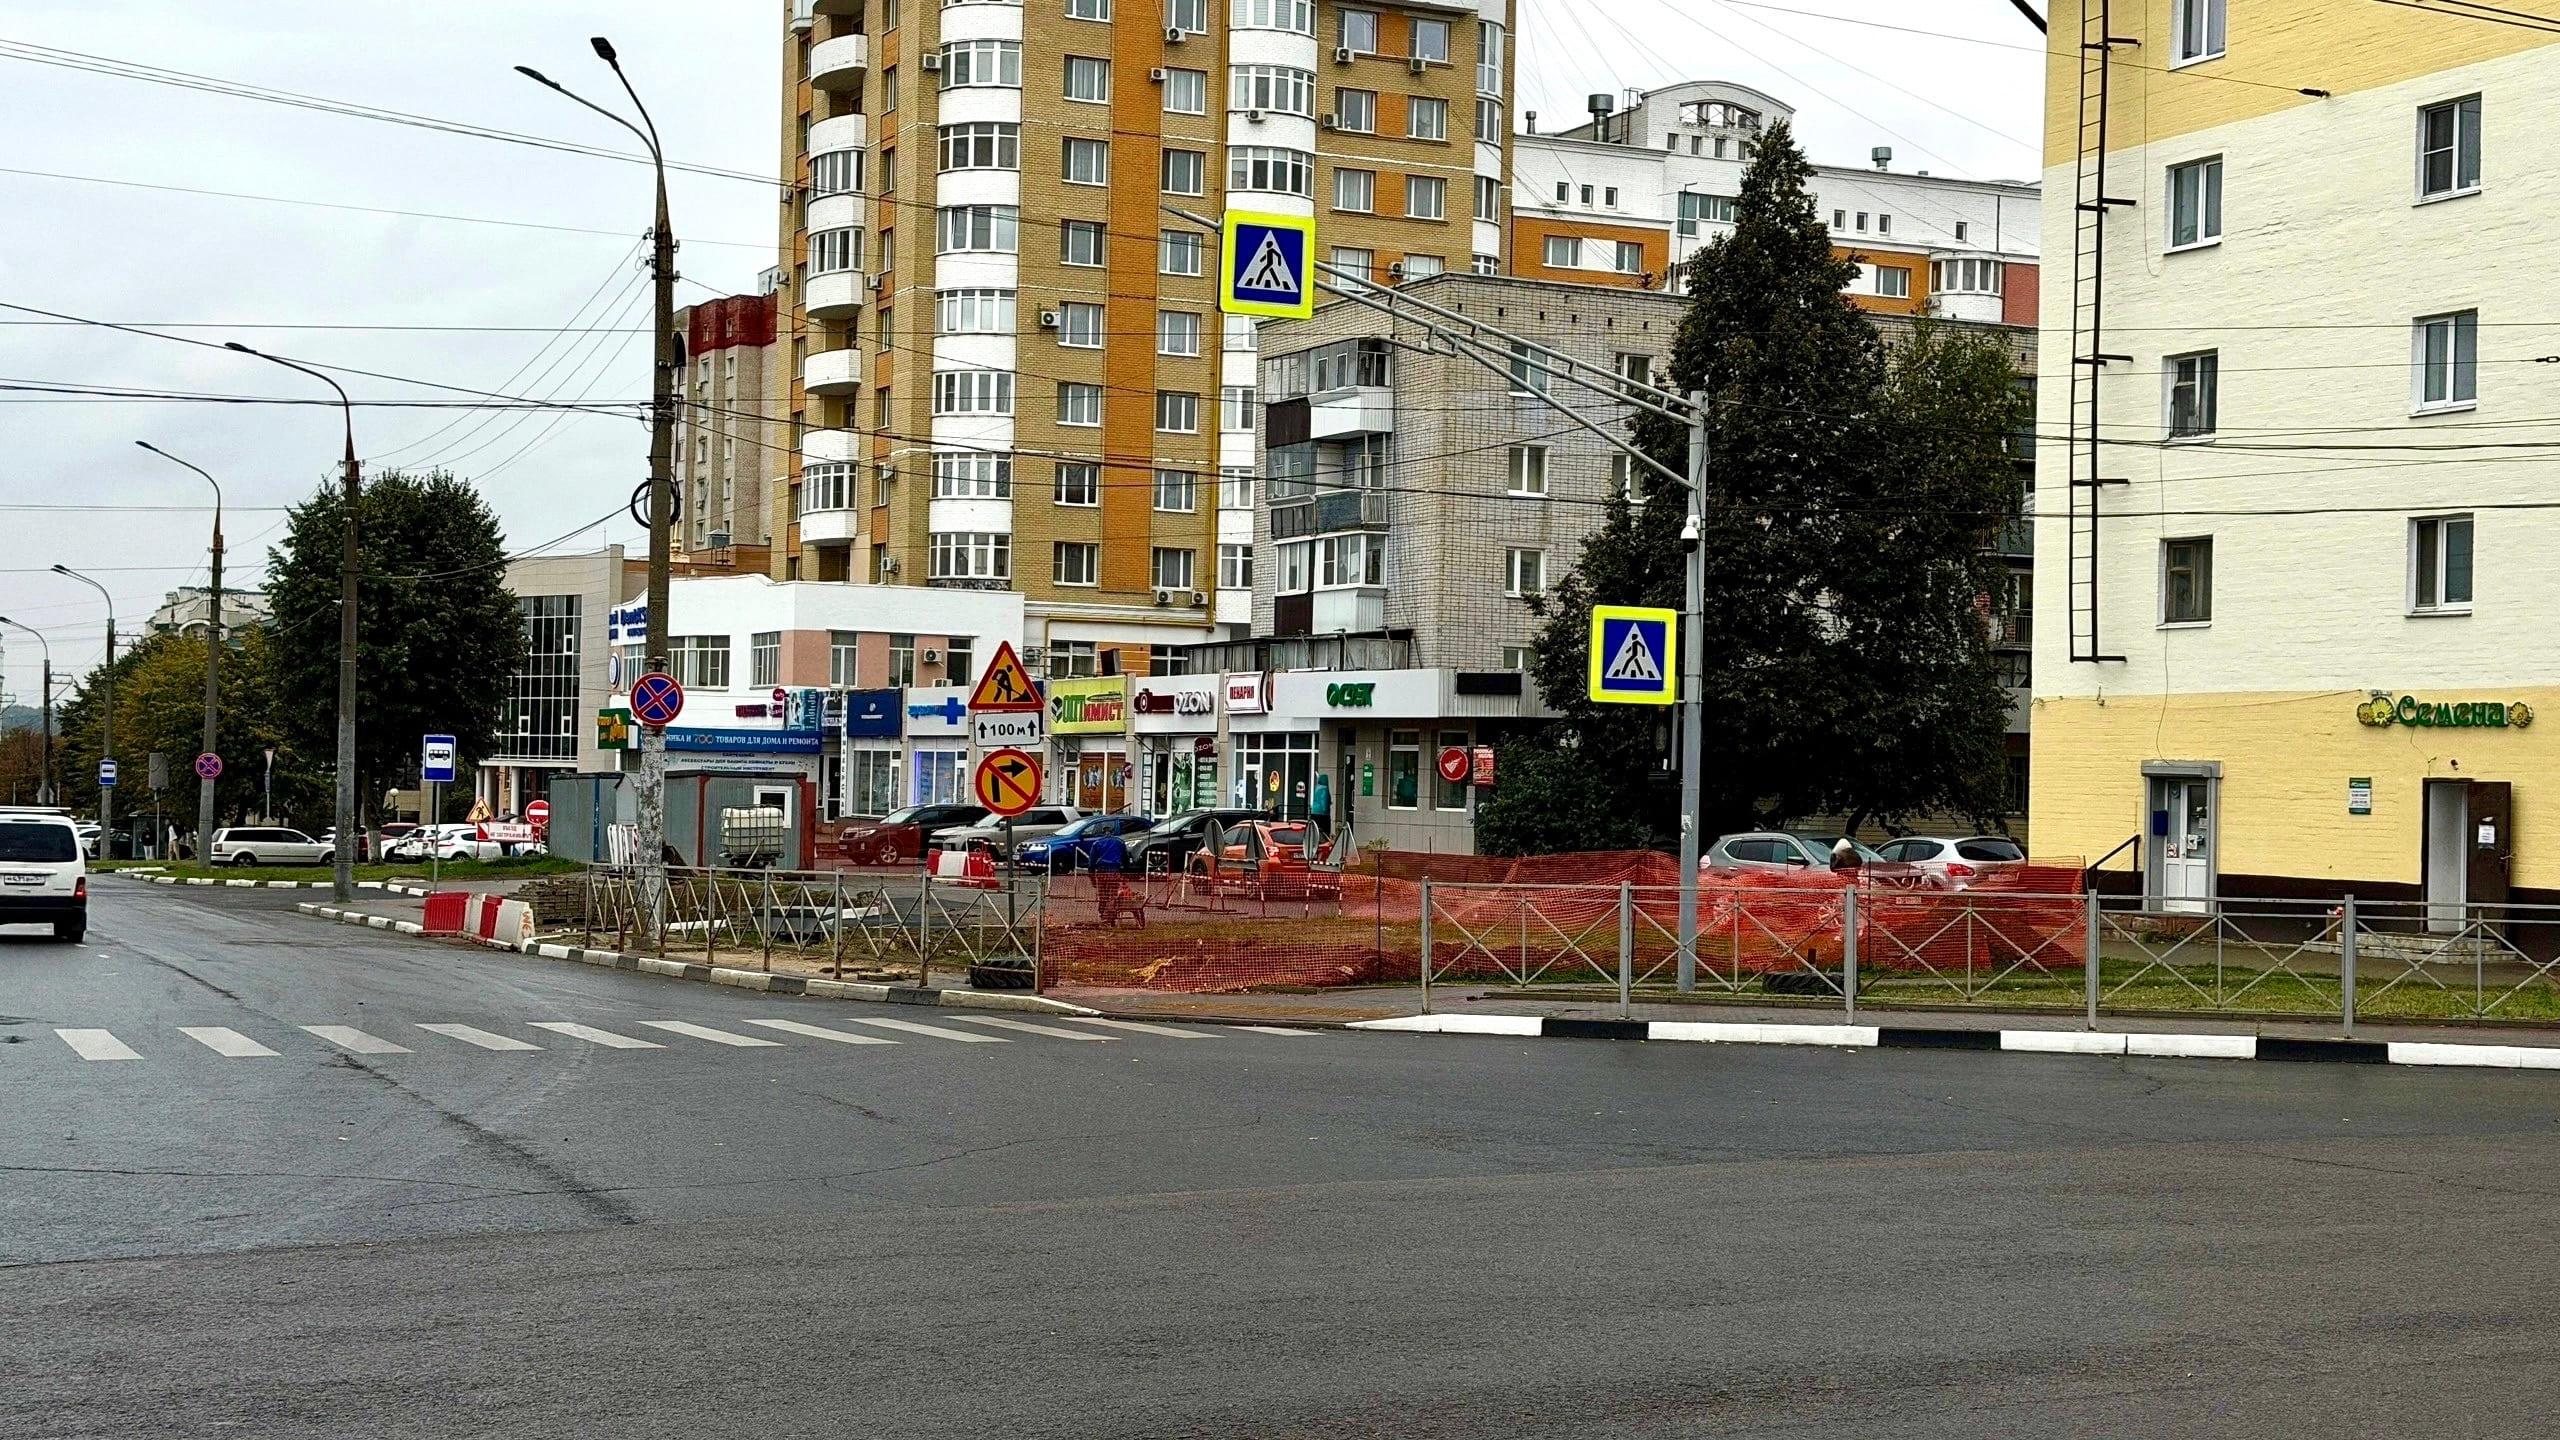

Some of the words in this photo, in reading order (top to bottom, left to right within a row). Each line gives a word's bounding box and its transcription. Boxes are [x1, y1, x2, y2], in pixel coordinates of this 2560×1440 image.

[1173, 691, 1213, 714] OZON
[2397, 695, 2508, 727] Семена
[715, 736, 746, 744] ТОВАРОВ
[746, 736, 761, 745] ДЛЯ
[761, 737, 781, 745] ДОМА
[782, 737, 788, 745] И
[788, 737, 819, 746] РЕМОНТА
